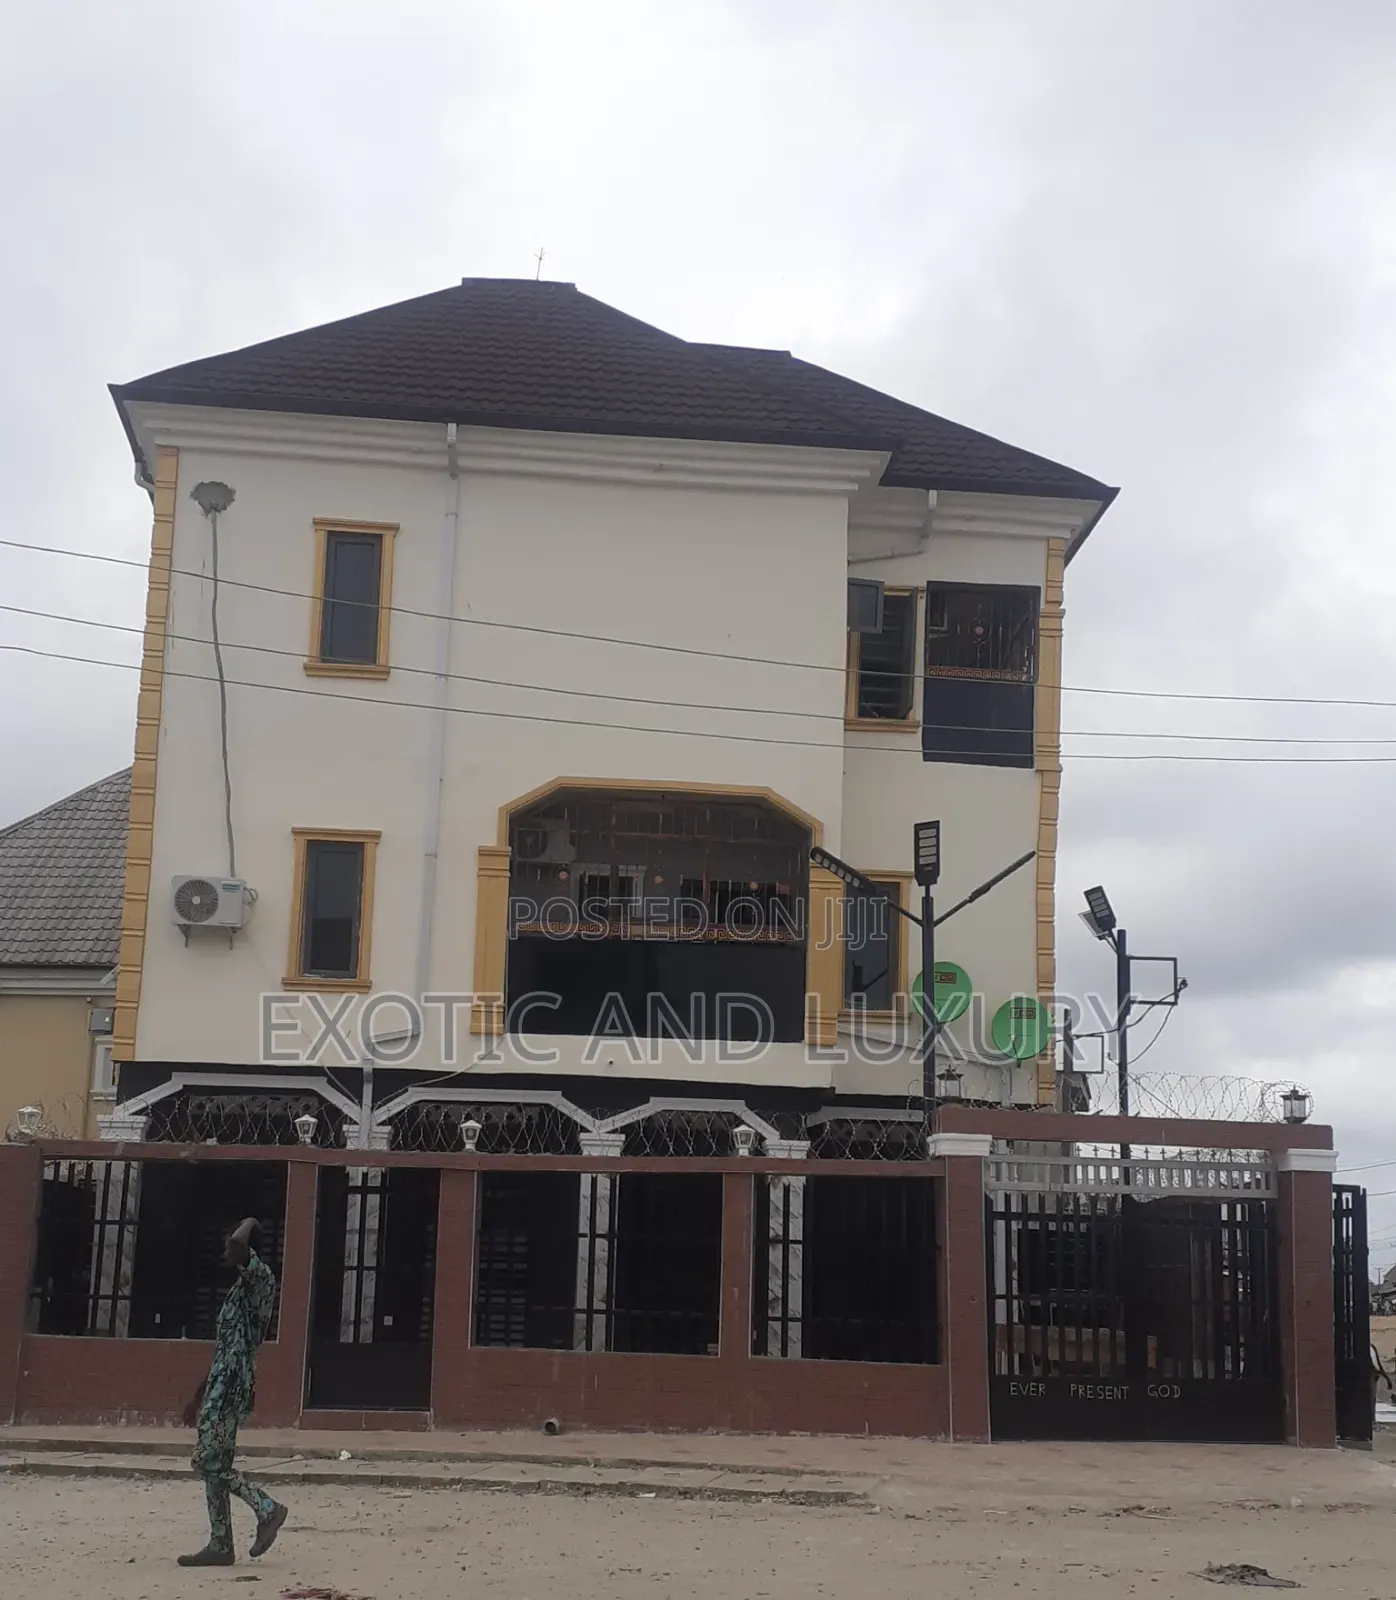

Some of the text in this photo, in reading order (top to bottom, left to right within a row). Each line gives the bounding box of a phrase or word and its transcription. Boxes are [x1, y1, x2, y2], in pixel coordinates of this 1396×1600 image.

[1009, 1381, 1181, 1400] EVER PRESENT GOD
